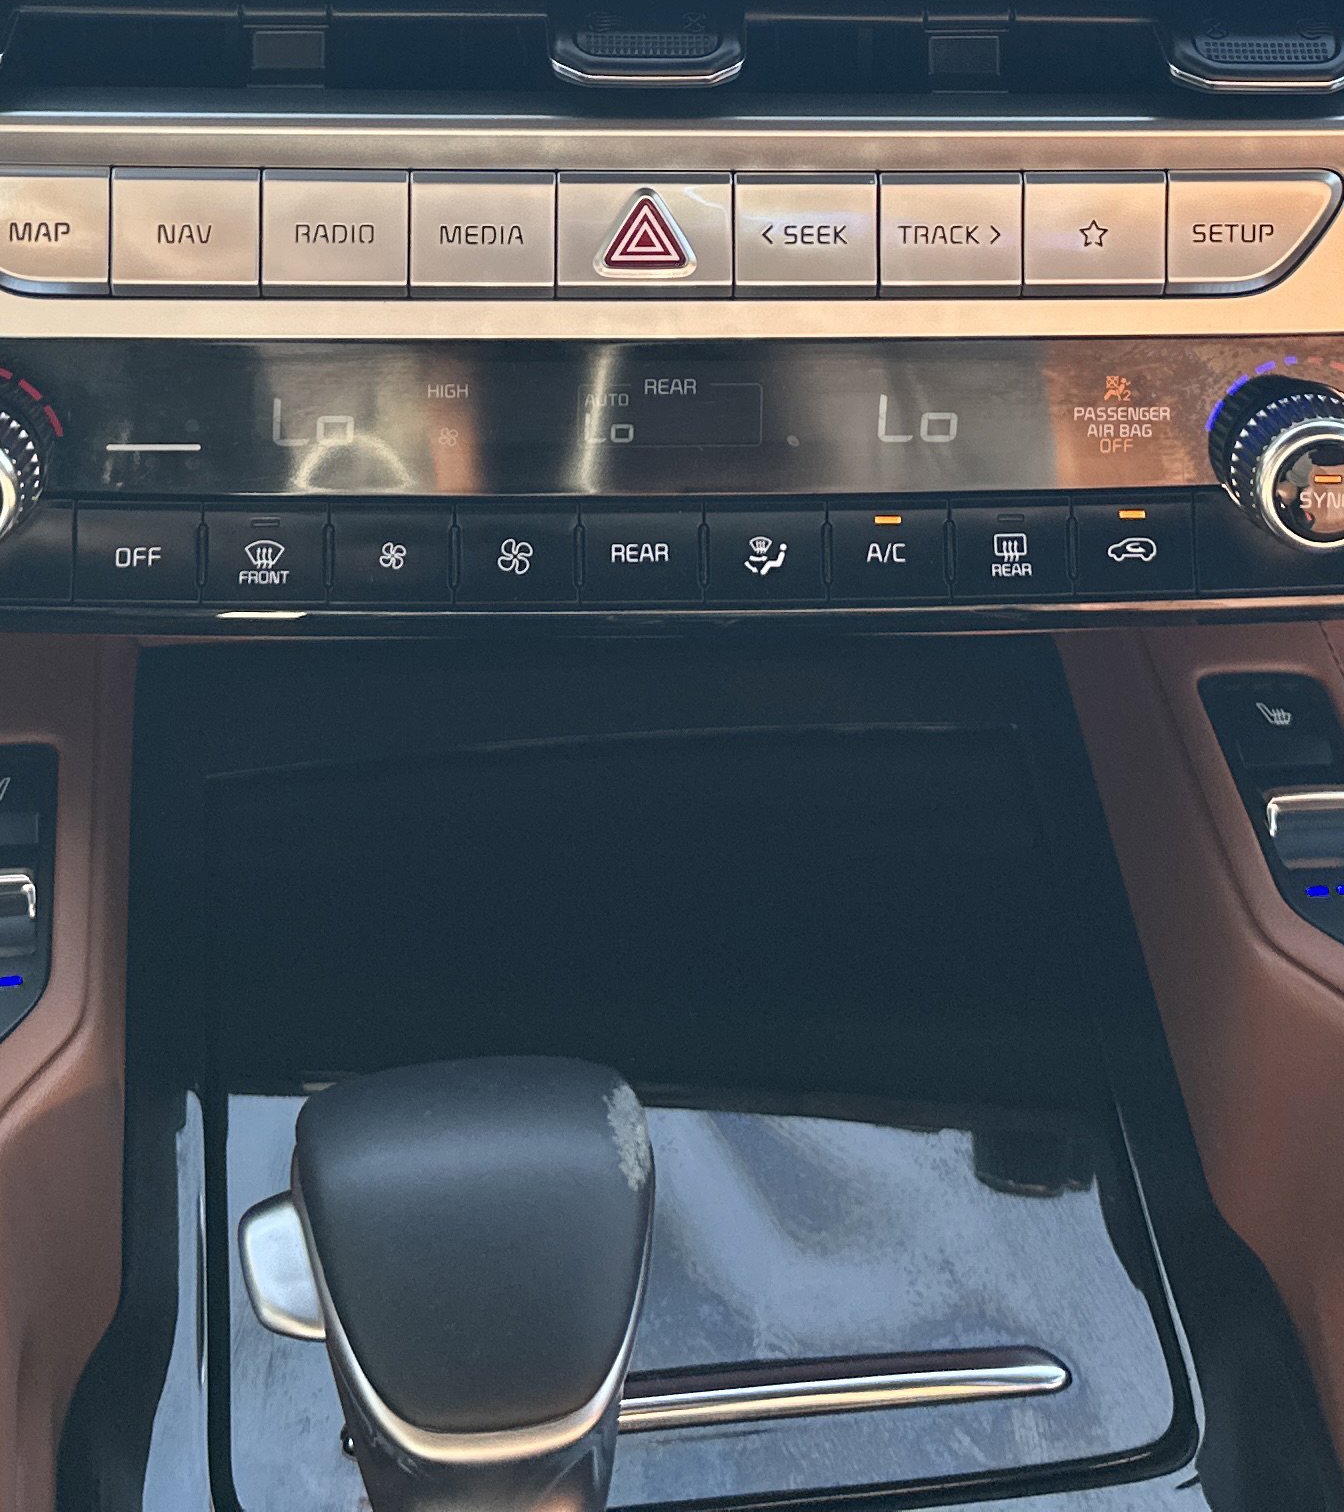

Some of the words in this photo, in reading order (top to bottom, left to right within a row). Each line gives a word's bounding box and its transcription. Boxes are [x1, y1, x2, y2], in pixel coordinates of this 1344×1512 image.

[9, 222, 70, 243] MAP
[157, 224, 212, 244] NAV
[295, 224, 375, 244] RADIO
[440, 225, 524, 245] MEDIA
[783, 225, 848, 245] SEEK
[897, 225, 980, 245] TRACK
[1192, 224, 1274, 243] SETUP
[427, 383, 470, 399] HIGH
[644, 378, 697, 395] REAR
[584, 393, 630, 407] AUTO
[272, 398, 355, 447] Lo
[877, 393, 958, 443] Lo
[1073, 406, 1171, 422] PASSENGER
[1087, 423, 1115, 438] AIR
[1119, 423, 1153, 438] BAG
[1099, 438, 1134, 454] OFF
[115, 546, 162, 568] OFF
[611, 543, 670, 563] REAR
[866, 543, 907, 563] A/C
[238, 570, 291, 585] FRONT
[991, 563, 1033, 577] REAR
